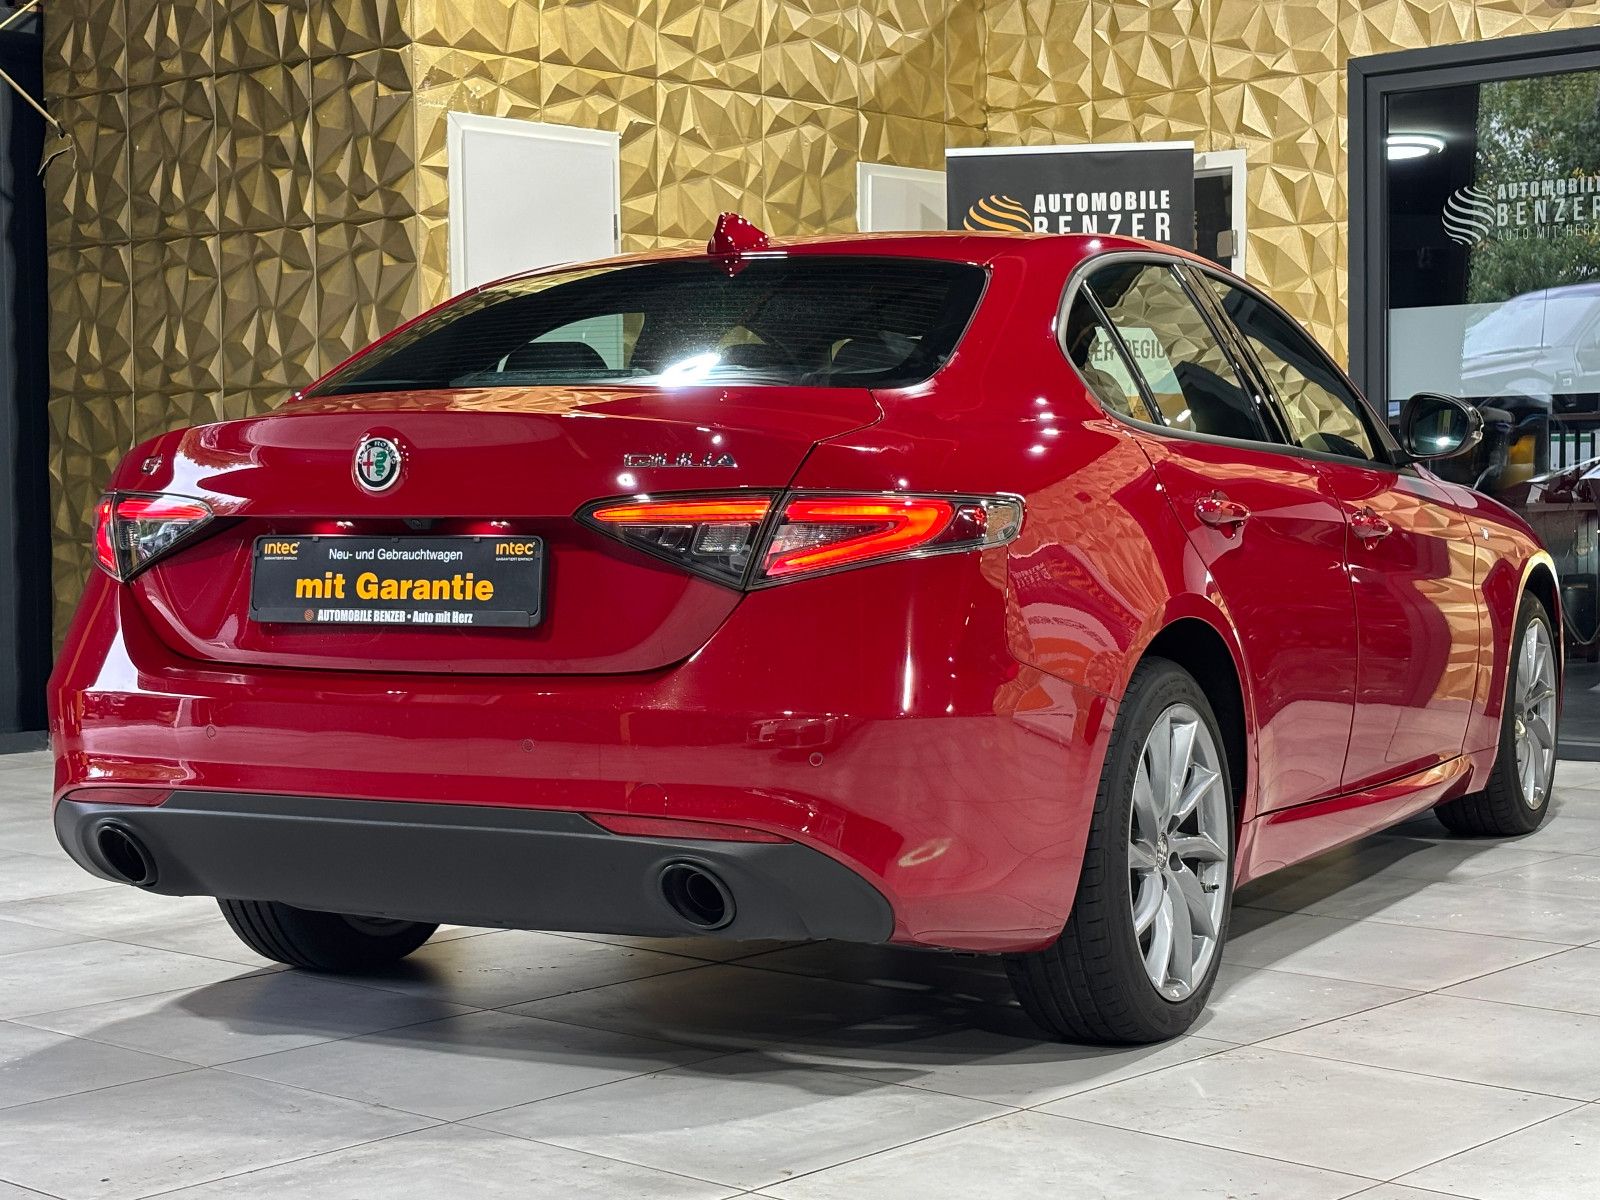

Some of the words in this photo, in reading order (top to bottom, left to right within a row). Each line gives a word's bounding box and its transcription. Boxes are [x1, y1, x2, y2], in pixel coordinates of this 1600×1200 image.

[1033, 190, 1170, 213] AUTOMOBILE
[1033, 212, 1171, 241] BENZER
[1497, 227, 1529, 241] AUTO
[1536, 225, 1557, 240] MIT
[1566, 222, 1599, 237] HERZ
[264, 541, 300, 555] intec
[329, 548, 353, 560] Neu-
[355, 548, 375, 560] und
[377, 548, 463, 563] Gebrauchtwagen
[495, 541, 535, 556] intec
[295, 571, 346, 599] mit
[356, 572, 494, 601] Garantie
[317, 609, 373, 622] AUTOMOBILE
[374, 610, 406, 623] BENZER
[412, 611, 434, 623] Auto
[435, 611, 451, 623] mit
[452, 611, 473, 624] Herz
